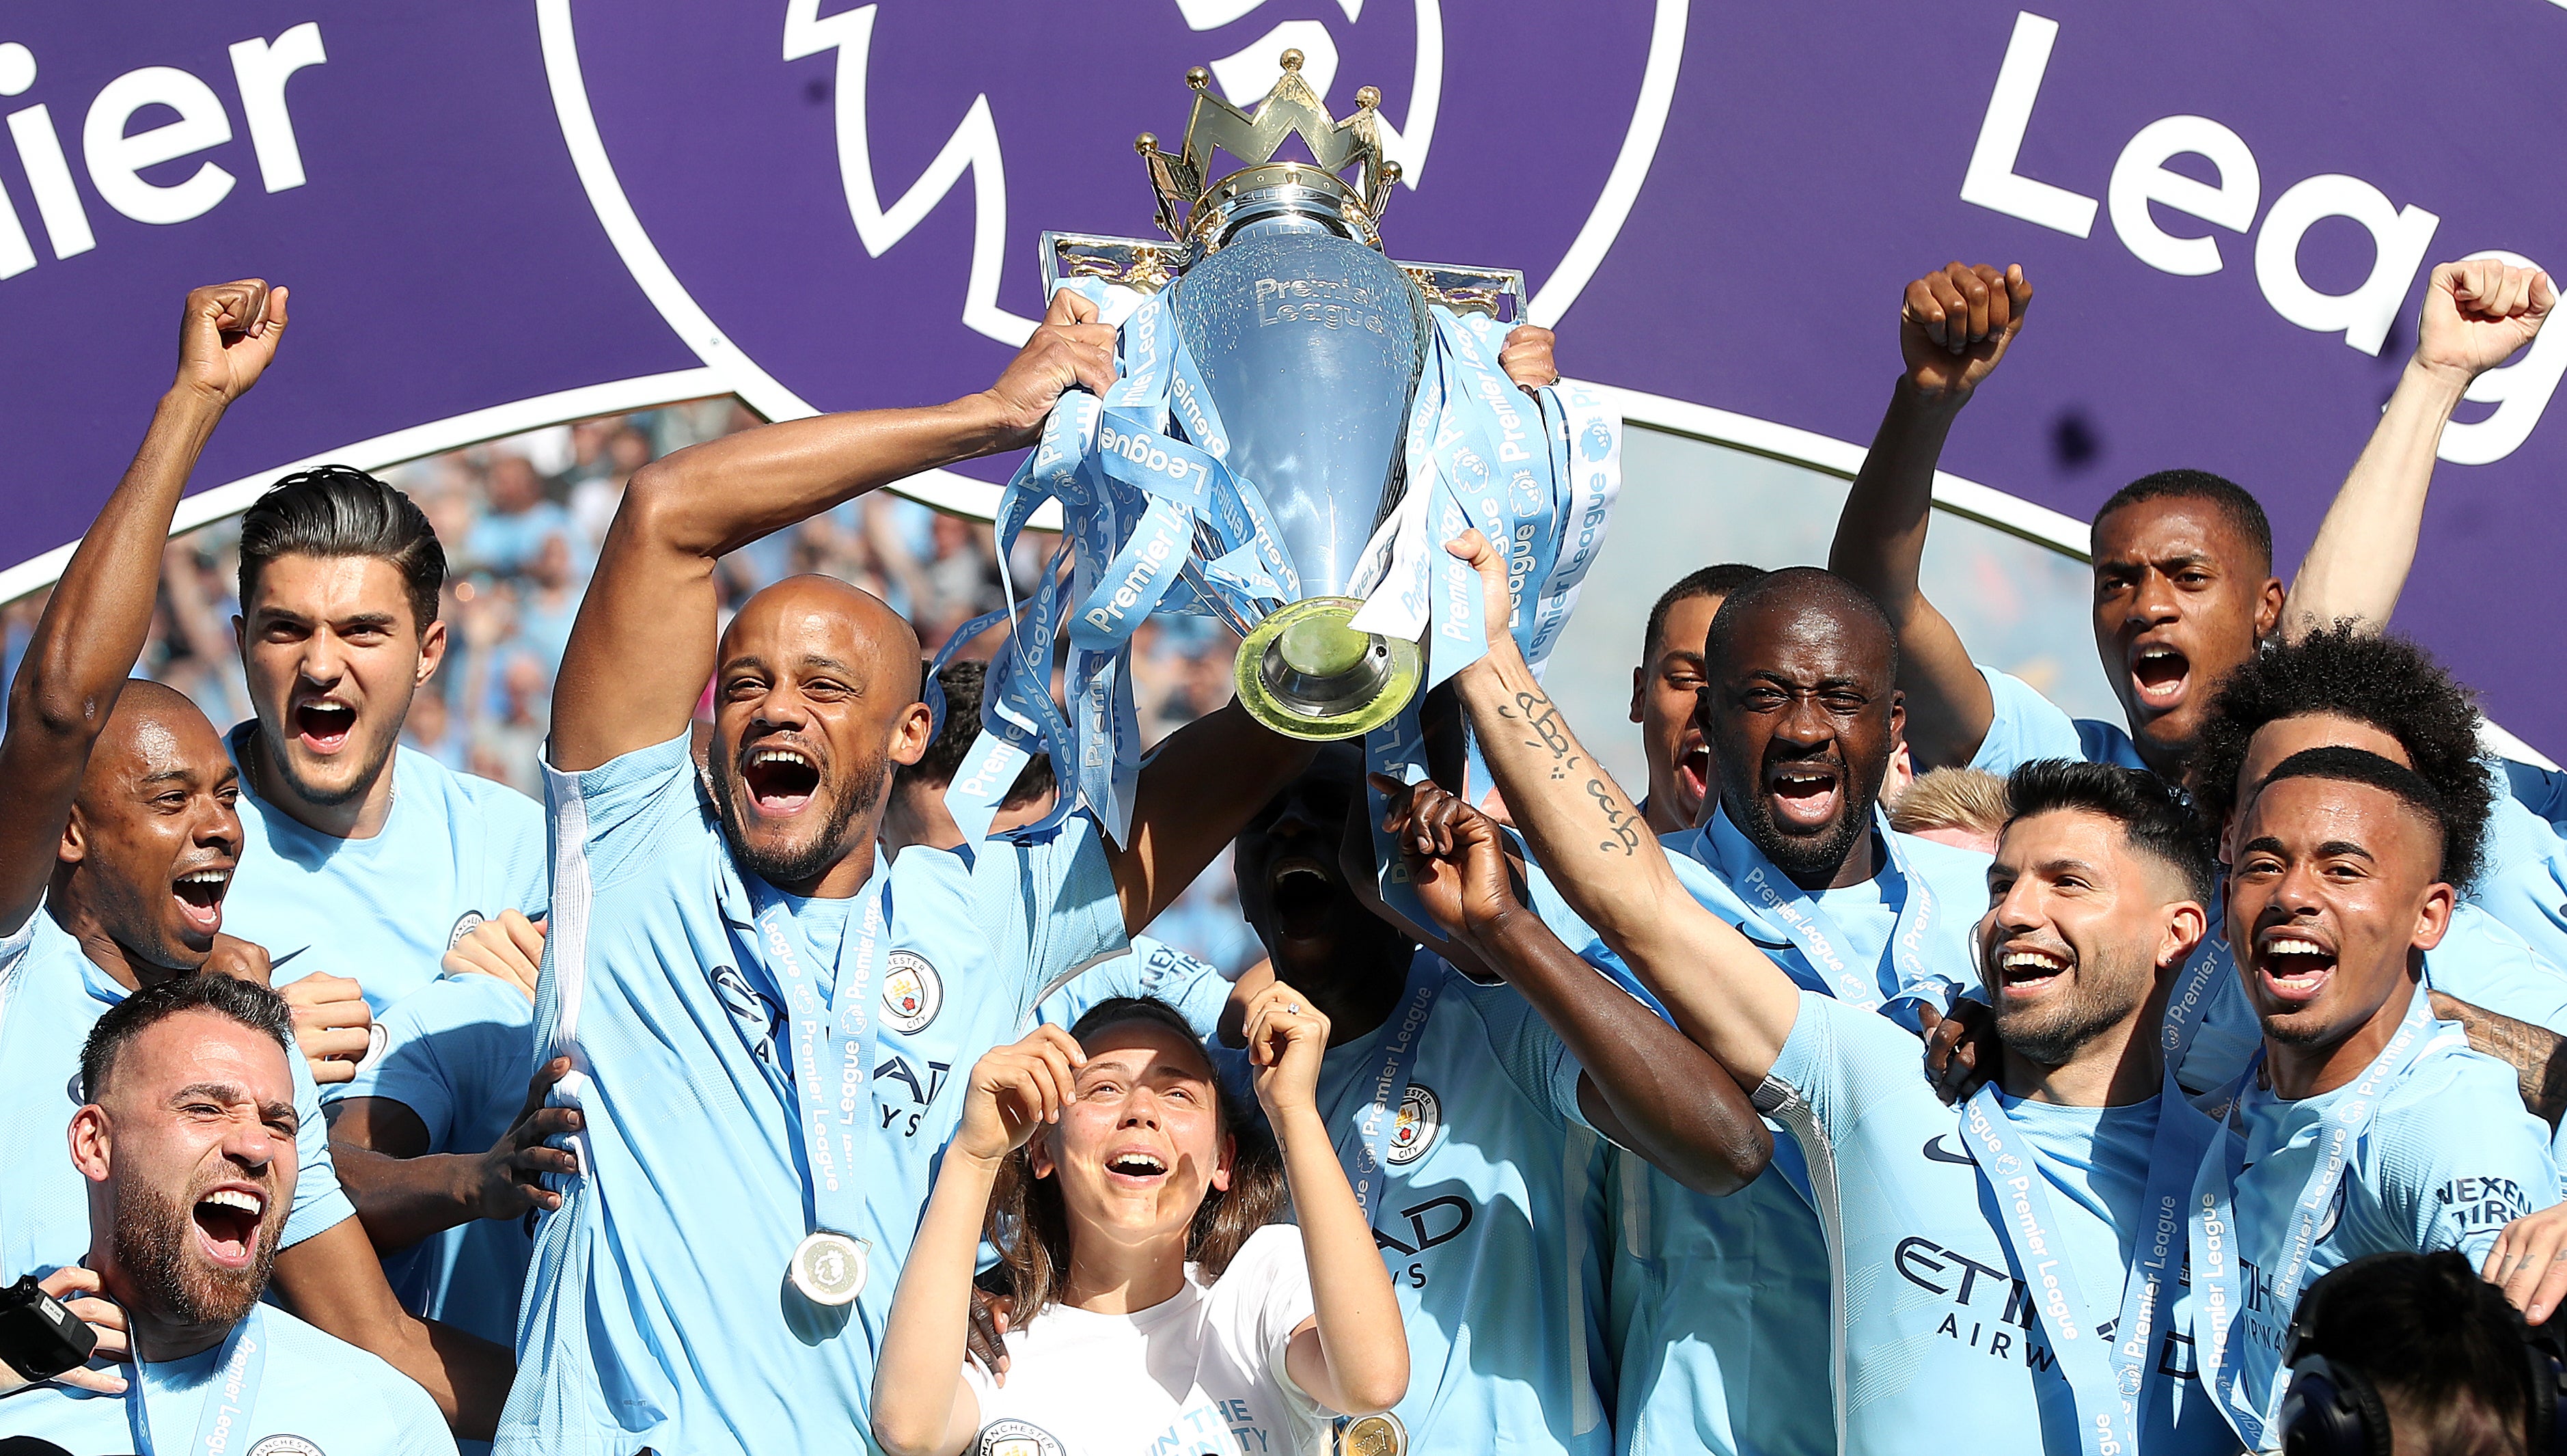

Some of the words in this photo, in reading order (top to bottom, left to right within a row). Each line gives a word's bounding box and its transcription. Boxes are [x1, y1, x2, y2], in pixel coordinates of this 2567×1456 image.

[1257, 301, 1384, 334] League
[1476, 370, 1530, 463] Premier
[1100, 426, 1209, 495] League
[1084, 527, 1176, 633] Premier
[759, 909, 801, 978] League
[855, 894, 884, 937] League
[1744, 866, 1802, 924] Premier
[1794, 917, 1844, 972] League
[845, 933, 877, 1000] Premier
[2169, 952, 2219, 1024] Premier
[907, 1015, 927, 1029] CITY
[840, 1040, 864, 1126] League
[1362, 1057, 1400, 1136] Premier
[1386, 987, 1432, 1054] League
[2359, 1028, 2417, 1098] Premier
[801, 1020, 823, 1103] Premier
[812, 1109, 839, 1192] League
[1399, 1146, 1418, 1159] CITY
[2201, 1193, 2225, 1278] League
[2275, 1213, 2316, 1298] Premier
[2303, 1127, 2348, 1211] League
[2007, 1175, 2049, 1256] Premier
[2037, 1259, 2078, 1340] League
[2123, 1272, 2163, 1360] Premier
[2143, 1195, 2178, 1270] League
[2208, 1284, 2228, 1369] Premier
[224, 1333, 258, 1404] Premier
[205, 1403, 243, 1456] Leagu
[982, 1424, 1055, 1456] MANCHESTER
[1183, 1399, 1254, 1433] THE
